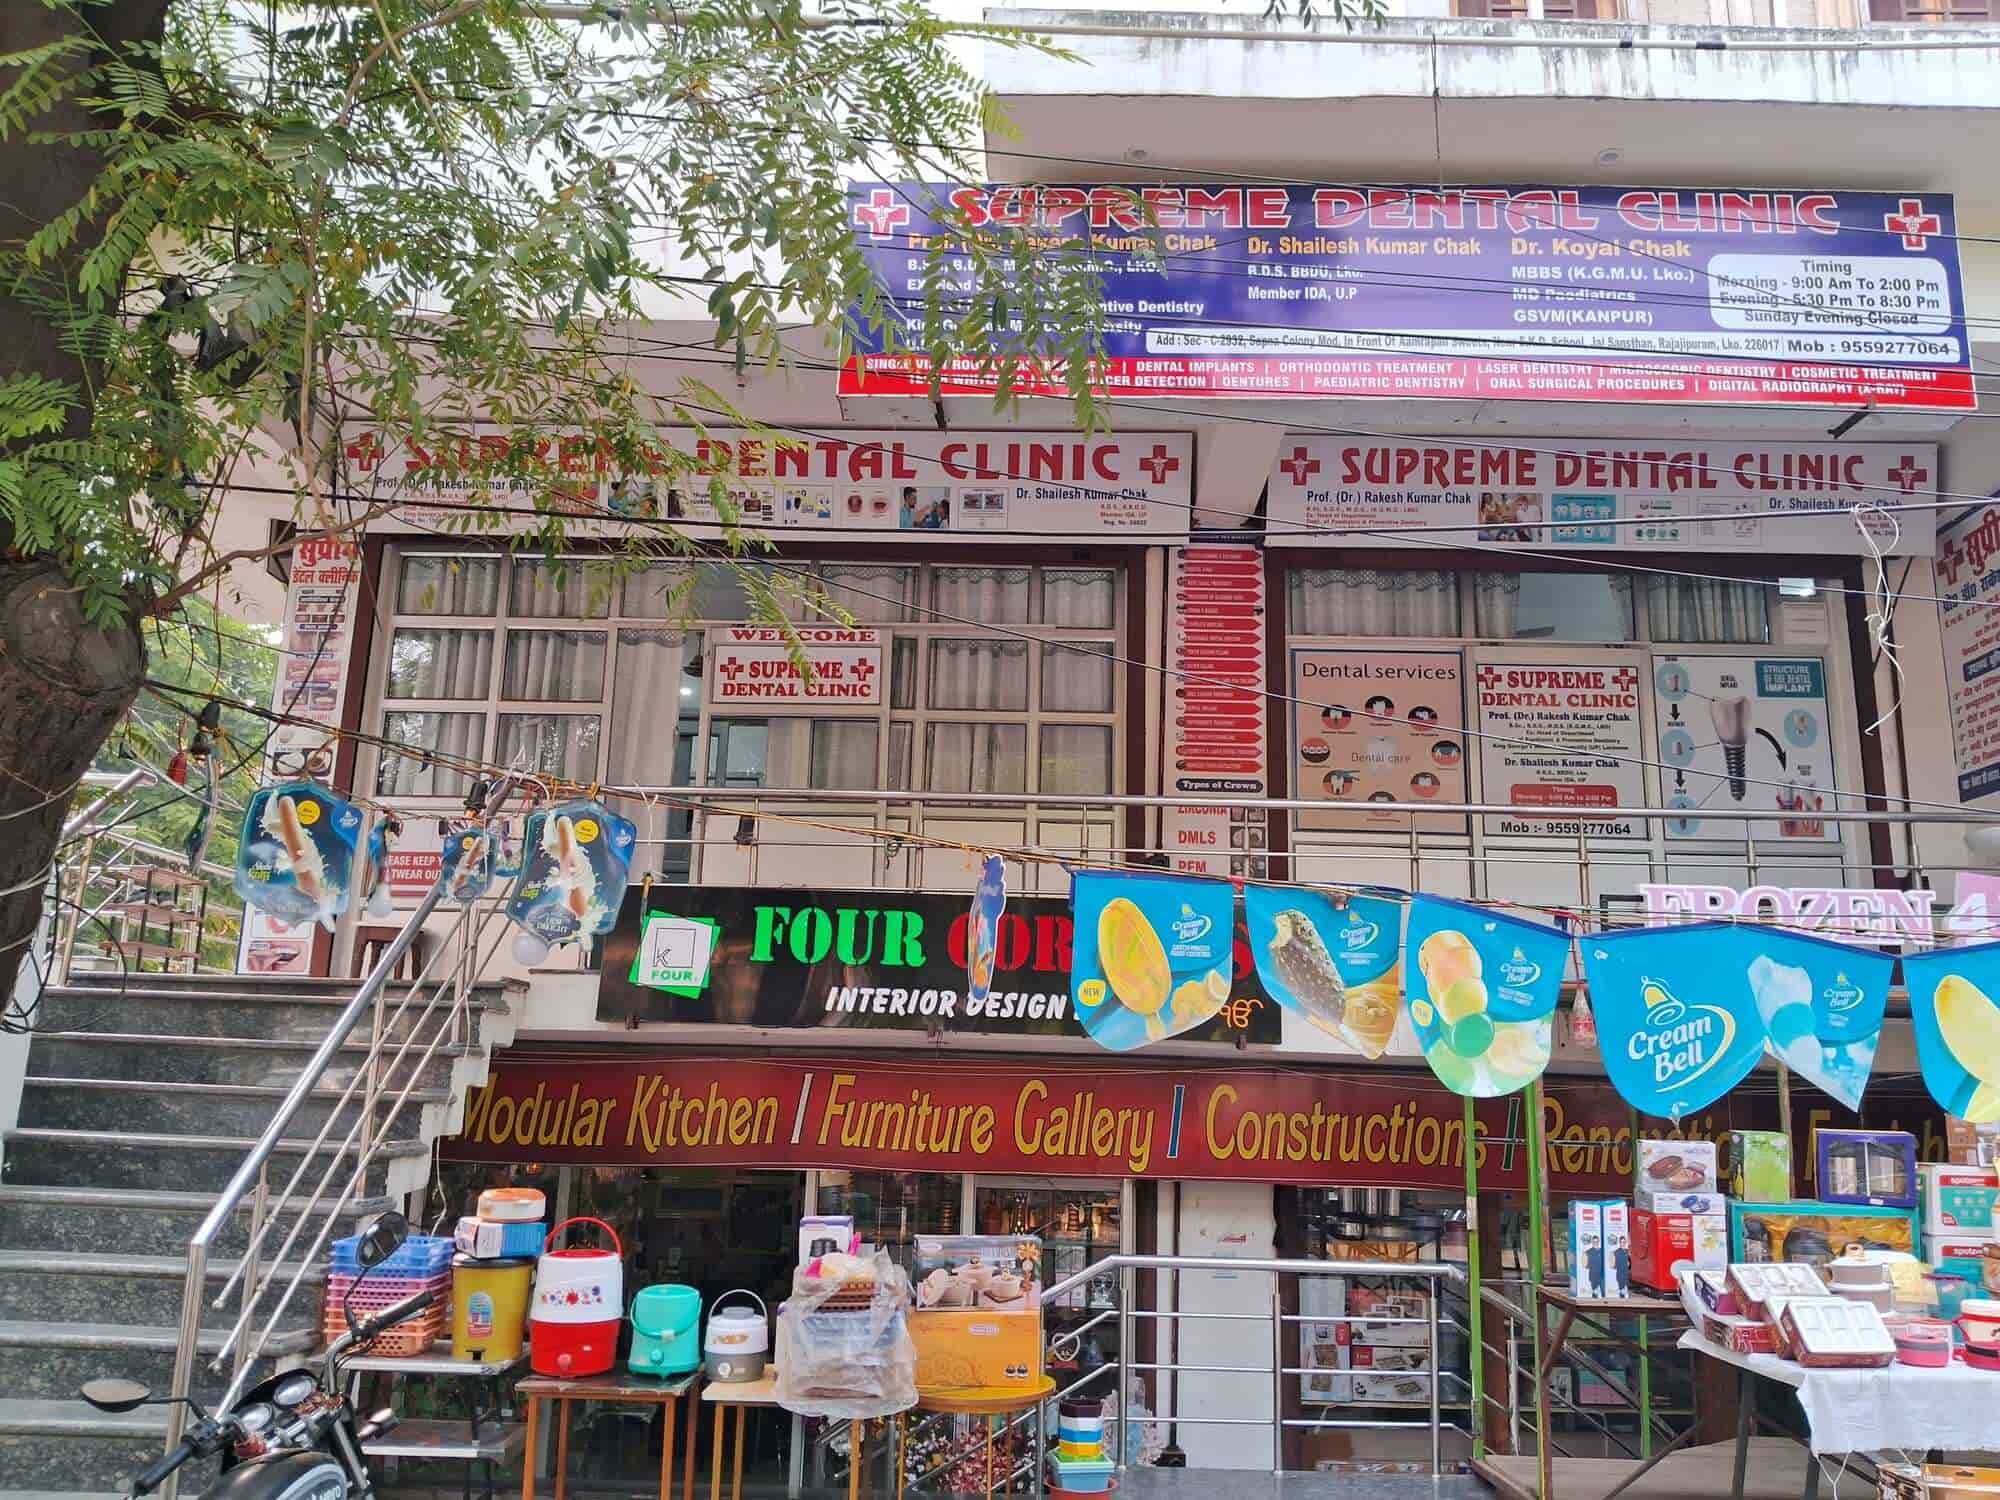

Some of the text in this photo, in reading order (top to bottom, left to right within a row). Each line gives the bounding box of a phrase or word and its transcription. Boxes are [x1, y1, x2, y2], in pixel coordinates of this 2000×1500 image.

[949, 185, 1840, 235] SUPREME DENTAL CLINIC
[1164, 233, 1217, 251] Chak
[1248, 236, 1482, 256] Dr. Shailesh Kumar Chak
[1511, 238, 1692, 260] Dr. Koyal Chak
[1511, 266, 1562, 280] MBBS
[1567, 267, 1648, 282] (K.G.M.U.
[1801, 260, 1852, 276] Timing
[1717, 276, 1939, 292] Morning 9:00 Am To 2:00 Pm
[1248, 286, 1301, 299] Member
[1138, 300, 1204, 316] Dentistry
[1719, 293, 1940, 310] Evening 5:30 Pm To 8:30 Pm
[1513, 308, 1655, 326] GSVM(KANPUR)
[1744, 310, 1799, 326] Sunday
[1804, 311, 1864, 327] Evening
[1155, 334, 1176, 346] Add
[1183, 335, 1201, 347] Sec
[1356, 336, 1382, 347] Front
[1787, 340, 1949, 355] Mob 9559277064
[1136, 360, 1185, 373] DENTAL
[1189, 361, 1255, 374] IMPLANTS
[1279, 361, 1372, 374] ORTHODONTIC
[1375, 362, 1453, 375] TREATMENT
[1477, 362, 1518, 375] LASER
[1523, 363, 1593, 376] DENTISTRY
[1714, 365, 1777, 378] DENTISTRY
[1791, 366, 1859, 379] COSMETIC
[1862, 368, 1938, 381] TREATMENT
[1134, 375, 1206, 388] DETECTION
[1222, 376, 1290, 388] DENTURES
[1314, 377, 1390, 389] PAEDIATRIC
[1395, 377, 1465, 389] DENTISTRY
[1489, 378, 1524, 390] ORAL
[1528, 379, 1594, 391] SURGICAL
[1597, 378, 1686, 391] PROCEDURES
[1707, 380, 1759, 393] DIGITAL
[1762, 380, 1853, 394] RADIOGRAPHY
[939, 442, 1121, 482] CLINIC
[1340, 446, 1865, 493] SUPREME DENTAL CLINIC
[1016, 487, 1031, 499] Dr.
[1035, 487, 1081, 500] Shailesh
[1306, 490, 1472, 504] Prof. (Dr.) Rakesh Kumar Chak
[1768, 497, 1836, 510] Dr. Shailesh
[731, 629, 876, 642] WELCOME
[1302, 662, 1457, 680] Dental services
[1507, 670, 1605, 690] SUPREME
[722, 682, 872, 698] DENTAL CLINIC
[1481, 692, 1636, 708] DENTAL CLINIC
[1537, 711, 1570, 721] Rakesh
[1572, 712, 1605, 721] Kumar
[1606, 713, 1630, 722] Chak
[1351, 752, 1385, 763] Dental
[1520, 758, 1560, 767] Shailesh
[1562, 759, 1594, 768] Kumar
[1595, 759, 1620, 769] Chak
[1182, 779, 1257, 791] Types of Crown
[1500, 821, 1530, 833] Mob
[1177, 830, 1217, 845] DMLS
[1638, 883, 1937, 946] FROZEN
[750, 905, 927, 968] FOUR
[651, 969, 693, 982] FOUR
[825, 986, 1067, 1021] INTERIOR DESIGN
[1627, 1013, 1713, 1060] Cream
[1653, 1040, 1706, 1084] Bell
[624, 1074, 779, 1154] Kitchen
[817, 1073, 996, 1154] Furniture
[1013, 1079, 1158, 1174] Gallery
